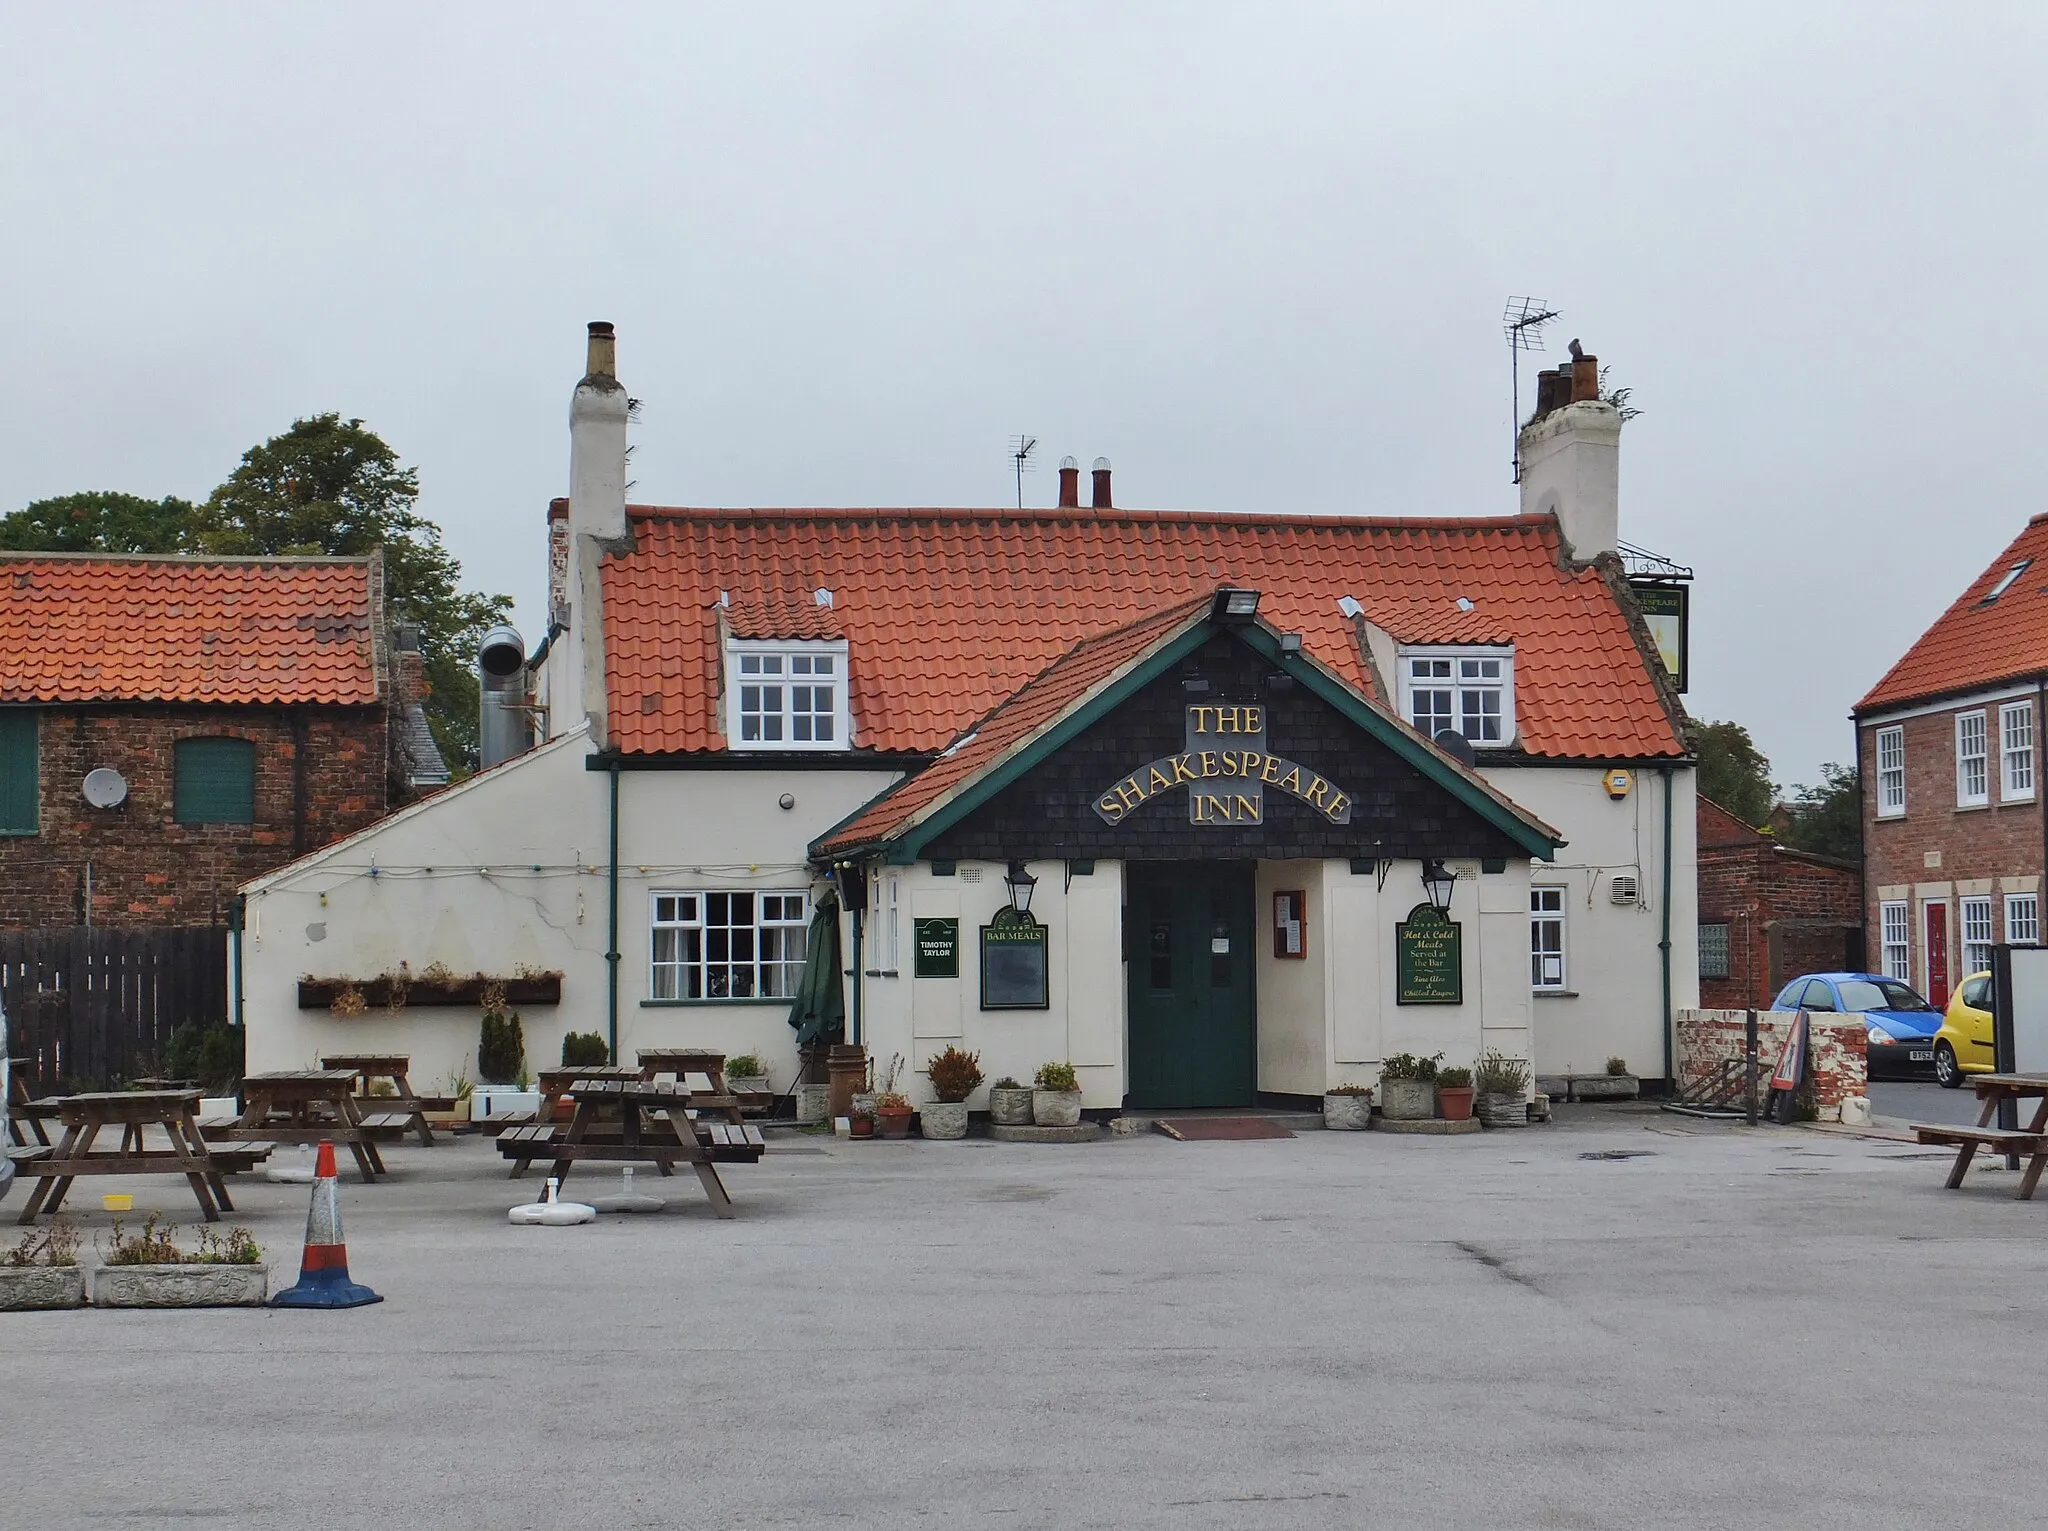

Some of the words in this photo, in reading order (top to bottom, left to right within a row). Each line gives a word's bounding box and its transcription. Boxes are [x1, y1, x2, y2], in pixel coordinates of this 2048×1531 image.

[1190, 706, 1263, 733] THE
[1100, 750, 1350, 822] SHAKESPEARE
[1194, 794, 1261, 823] INN
[987, 932, 1006, 940] BAR
[1008, 932, 1041, 940] MEALS
[1403, 930, 1421, 939] Hot
[1422, 931, 1431, 939] &
[1432, 930, 1454, 939] Cold
[1414, 940, 1443, 949] Meals
[1410, 950, 1437, 958] Served
[1414, 959, 1427, 967] the
[1429, 959, 1443, 967] Bar
